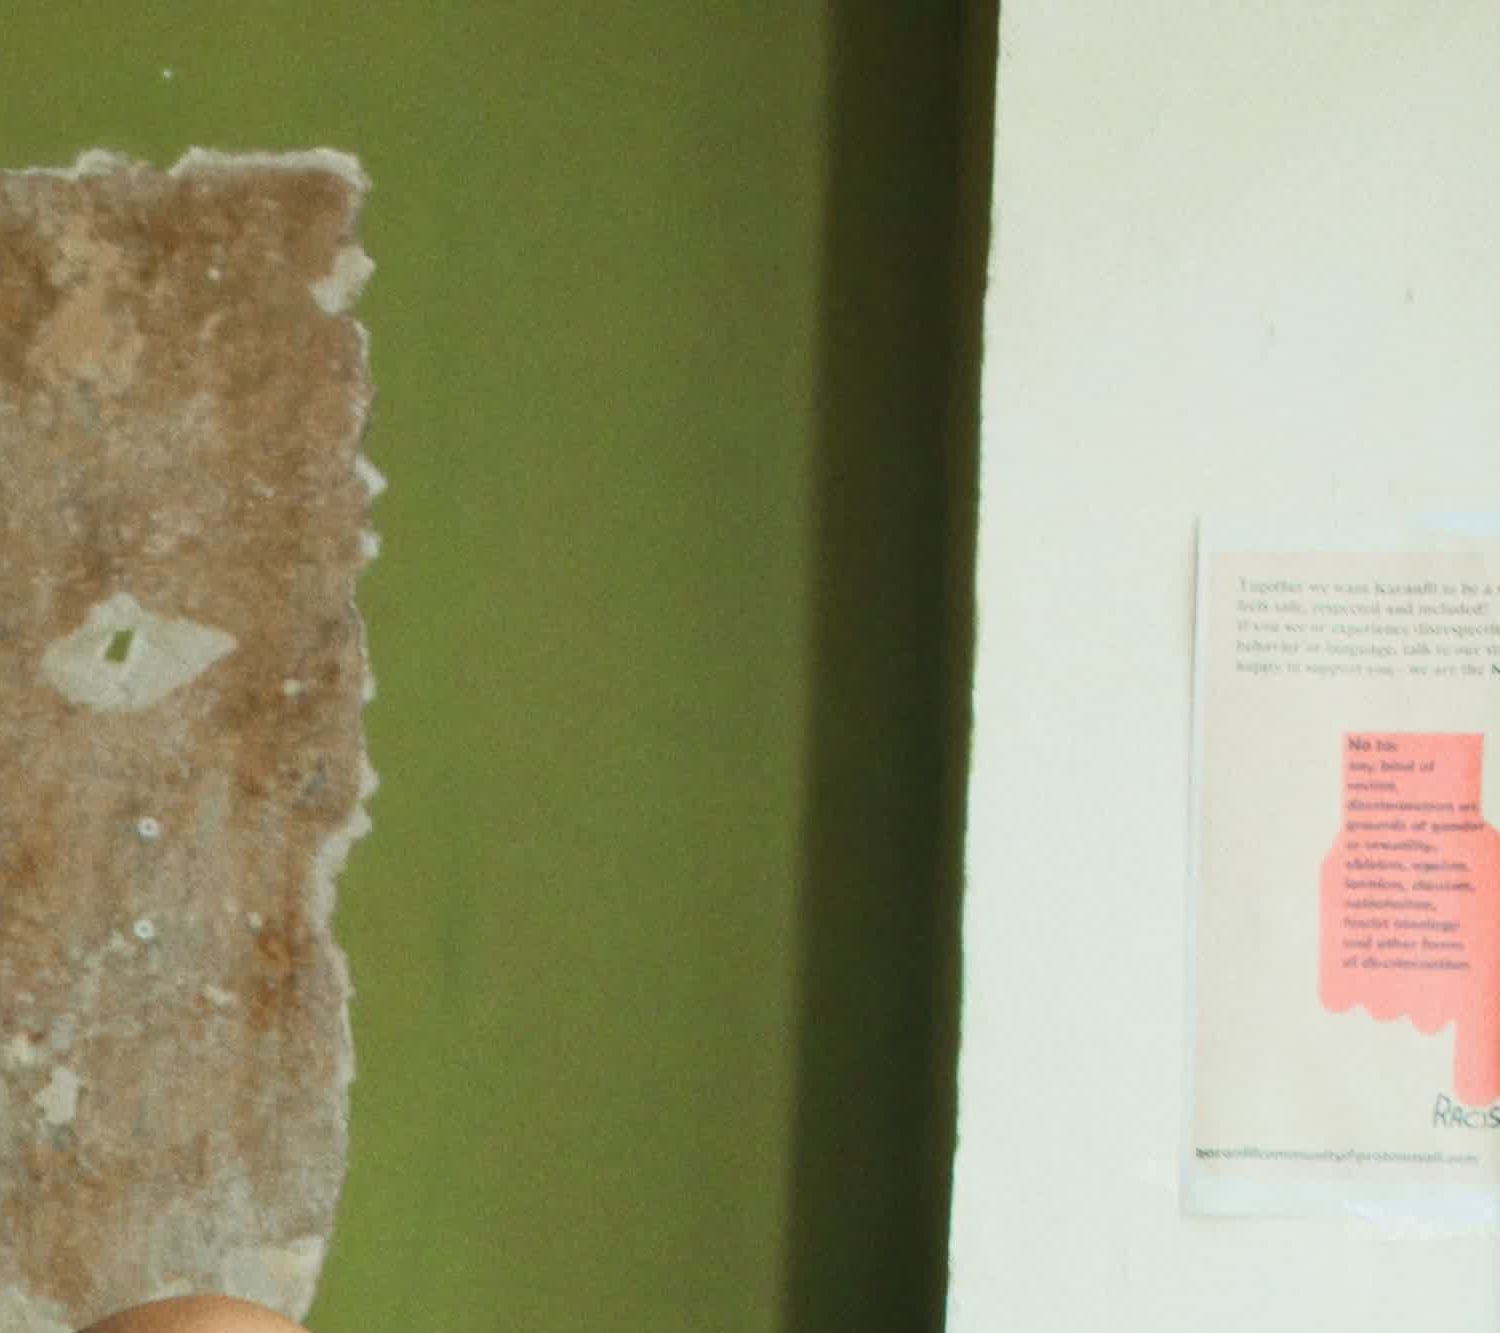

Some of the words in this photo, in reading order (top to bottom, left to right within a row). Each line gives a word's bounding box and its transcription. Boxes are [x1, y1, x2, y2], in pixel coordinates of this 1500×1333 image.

[1385, 603, 1413, 615] and
[1348, 736, 1372, 752] No
[1418, 760, 1436, 773] of
[1410, 820, 1428, 832] of
[1342, 936, 1372, 950] and
[1341, 956, 1358, 969] of
